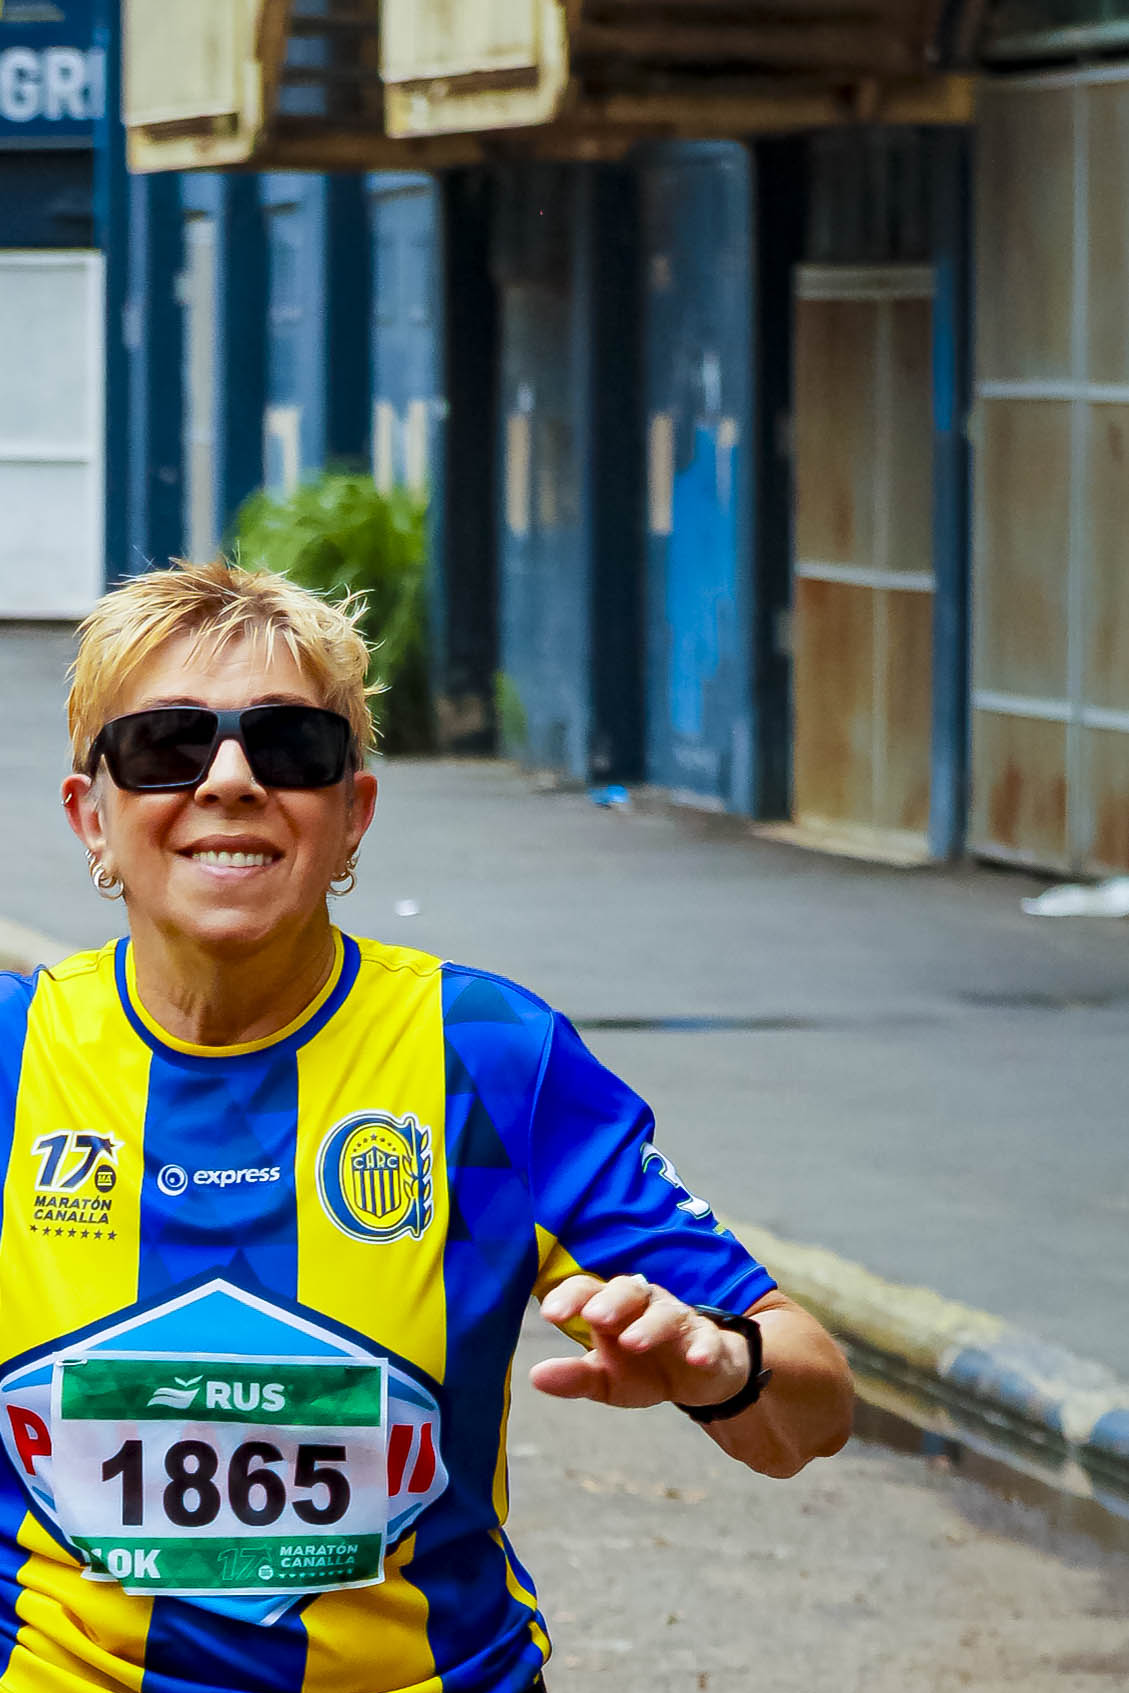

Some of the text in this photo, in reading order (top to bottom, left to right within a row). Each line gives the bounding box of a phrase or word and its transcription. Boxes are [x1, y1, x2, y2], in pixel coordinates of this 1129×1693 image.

[193, 1165, 281, 1193] express
[34, 1194, 112, 1211] MARATÓN
[33, 1208, 109, 1224] CANALLA
[205, 1381, 286, 1411] RUS
[101, 1439, 351, 1527] 1865
[280, 1542, 359, 1556] MARATÓN
[280, 1555, 355, 1568] CANALLA
